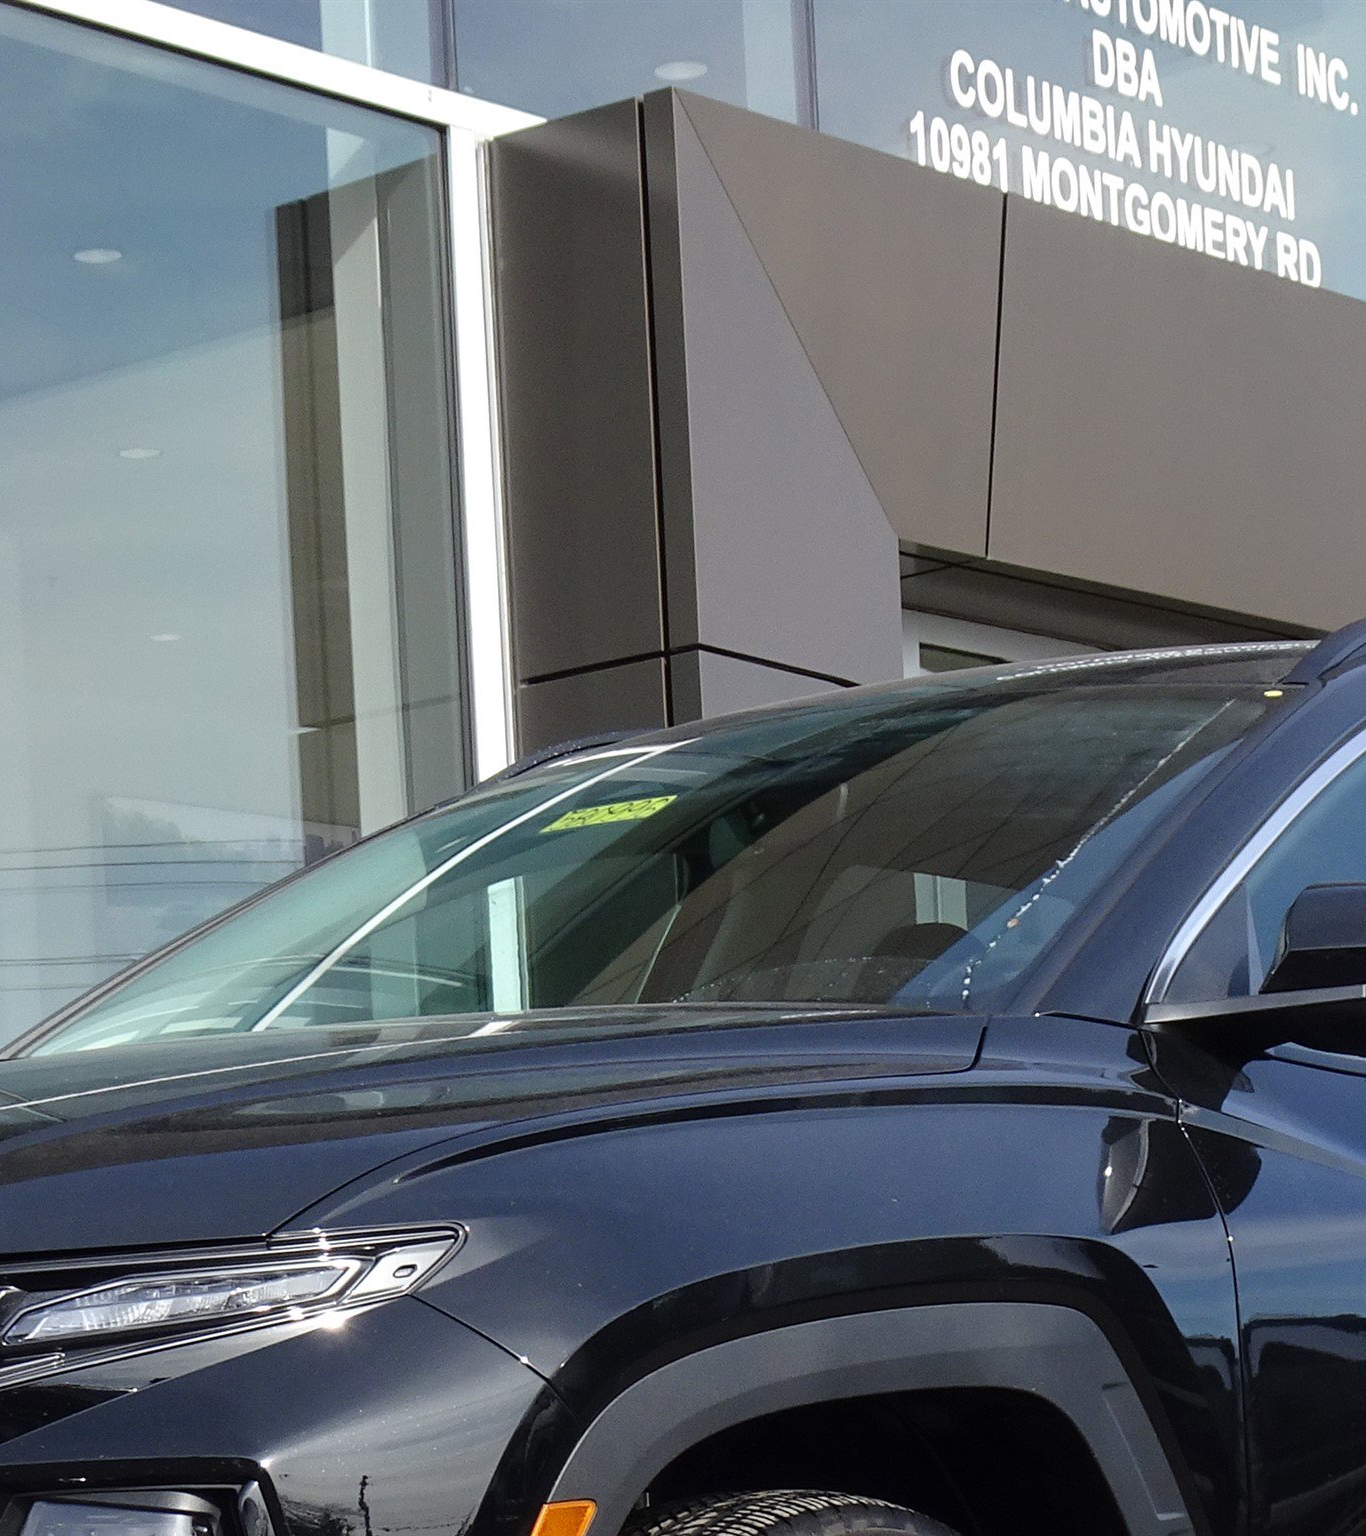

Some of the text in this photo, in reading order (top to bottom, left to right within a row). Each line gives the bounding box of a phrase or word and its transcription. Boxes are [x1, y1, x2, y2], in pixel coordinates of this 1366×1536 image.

[1080, 0, 1358, 115] OMOTIVE INC.
[1092, 29, 1163, 107] DBA
[910, 110, 1321, 288] 10981 MONTGOMERY RD
[950, 50, 1295, 221] COLUMBIA HYUNDAI
